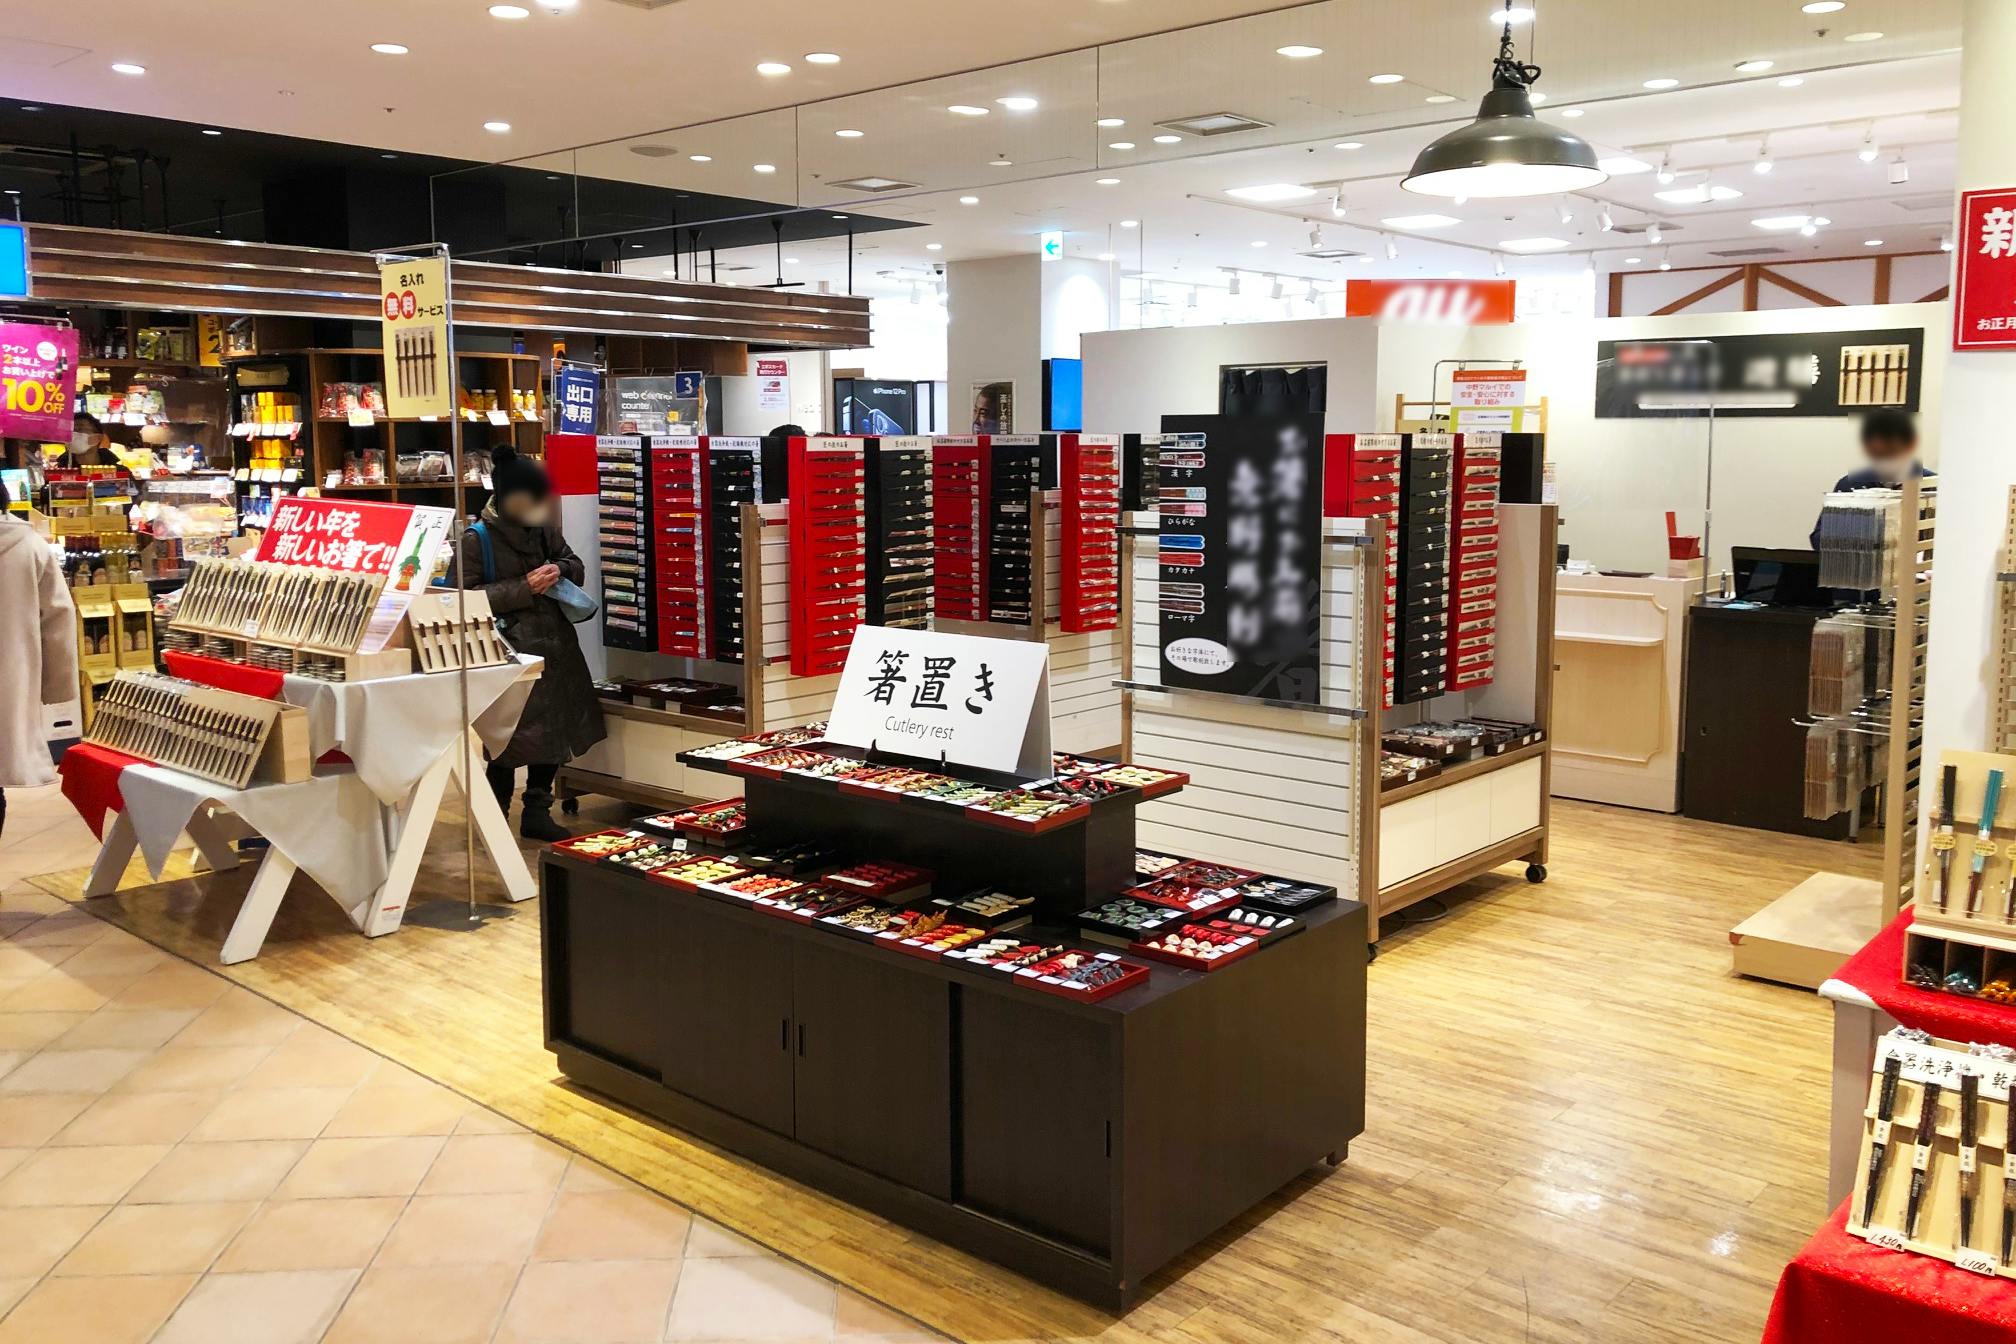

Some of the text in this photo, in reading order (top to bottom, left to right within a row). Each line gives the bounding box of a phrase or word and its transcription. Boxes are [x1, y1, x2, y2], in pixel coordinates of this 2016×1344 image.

[400, 273, 424, 287] 名入れ
[386, 295, 444, 317] 無料 サービス
[2, 344, 29, 354] ワイン
[3, 354, 41, 367] 2本以上
[2, 366, 56, 379] お買い上げで
[683, 377, 693, 395] 3
[567, 384, 593, 403] 出口
[621, 391, 639, 400] web
[43, 402, 65, 414] OFF
[621, 402, 650, 410] counter
[565, 404, 593, 423] 専用
[273, 505, 361, 538] 新しい年を
[1167, 518, 1196, 526] ひらがな
[272, 533, 397, 570] 新しいお箸で!!
[1168, 566, 1196, 574] カタカナ
[1167, 614, 1196, 623] ローマ字
[864, 649, 994, 715] 箸置き
[885, 715, 955, 740] Cutlery rest
